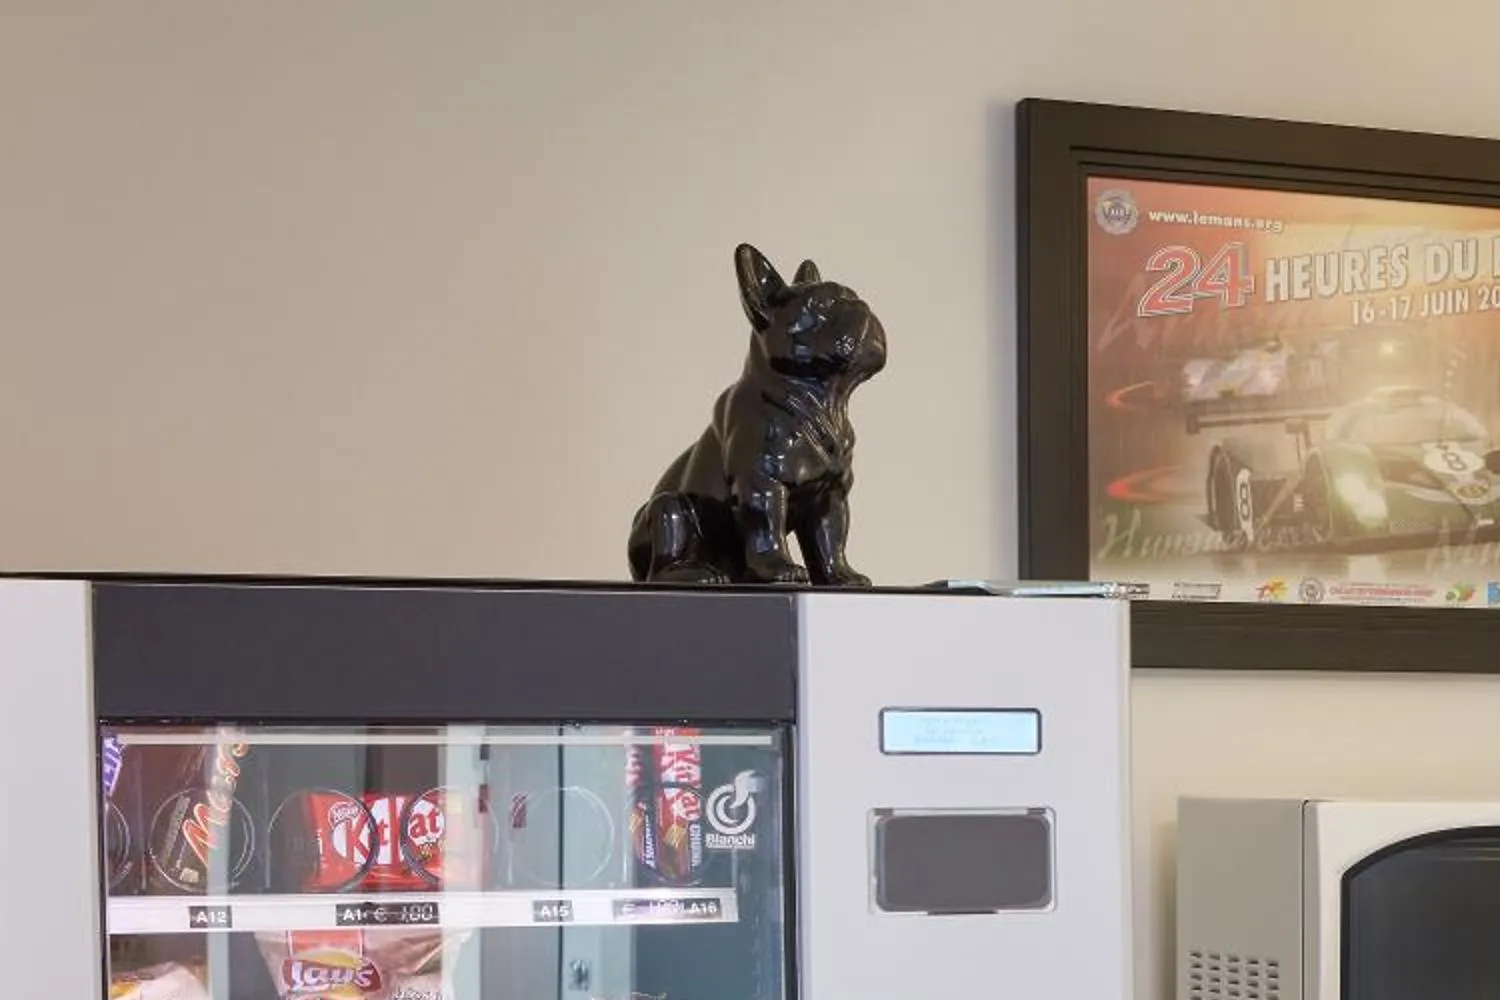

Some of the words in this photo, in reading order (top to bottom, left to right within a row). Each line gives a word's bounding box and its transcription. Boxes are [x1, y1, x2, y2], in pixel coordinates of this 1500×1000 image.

[1138, 242, 1257, 317] 24
[1265, 245, 1409, 303] HEURES
[1423, 238, 1479, 285] DU
[1419, 287, 1470, 319] JUIN
[705, 833, 755, 847] Bianchi
[195, 911, 227, 924] A12
[539, 904, 569, 918] A15
